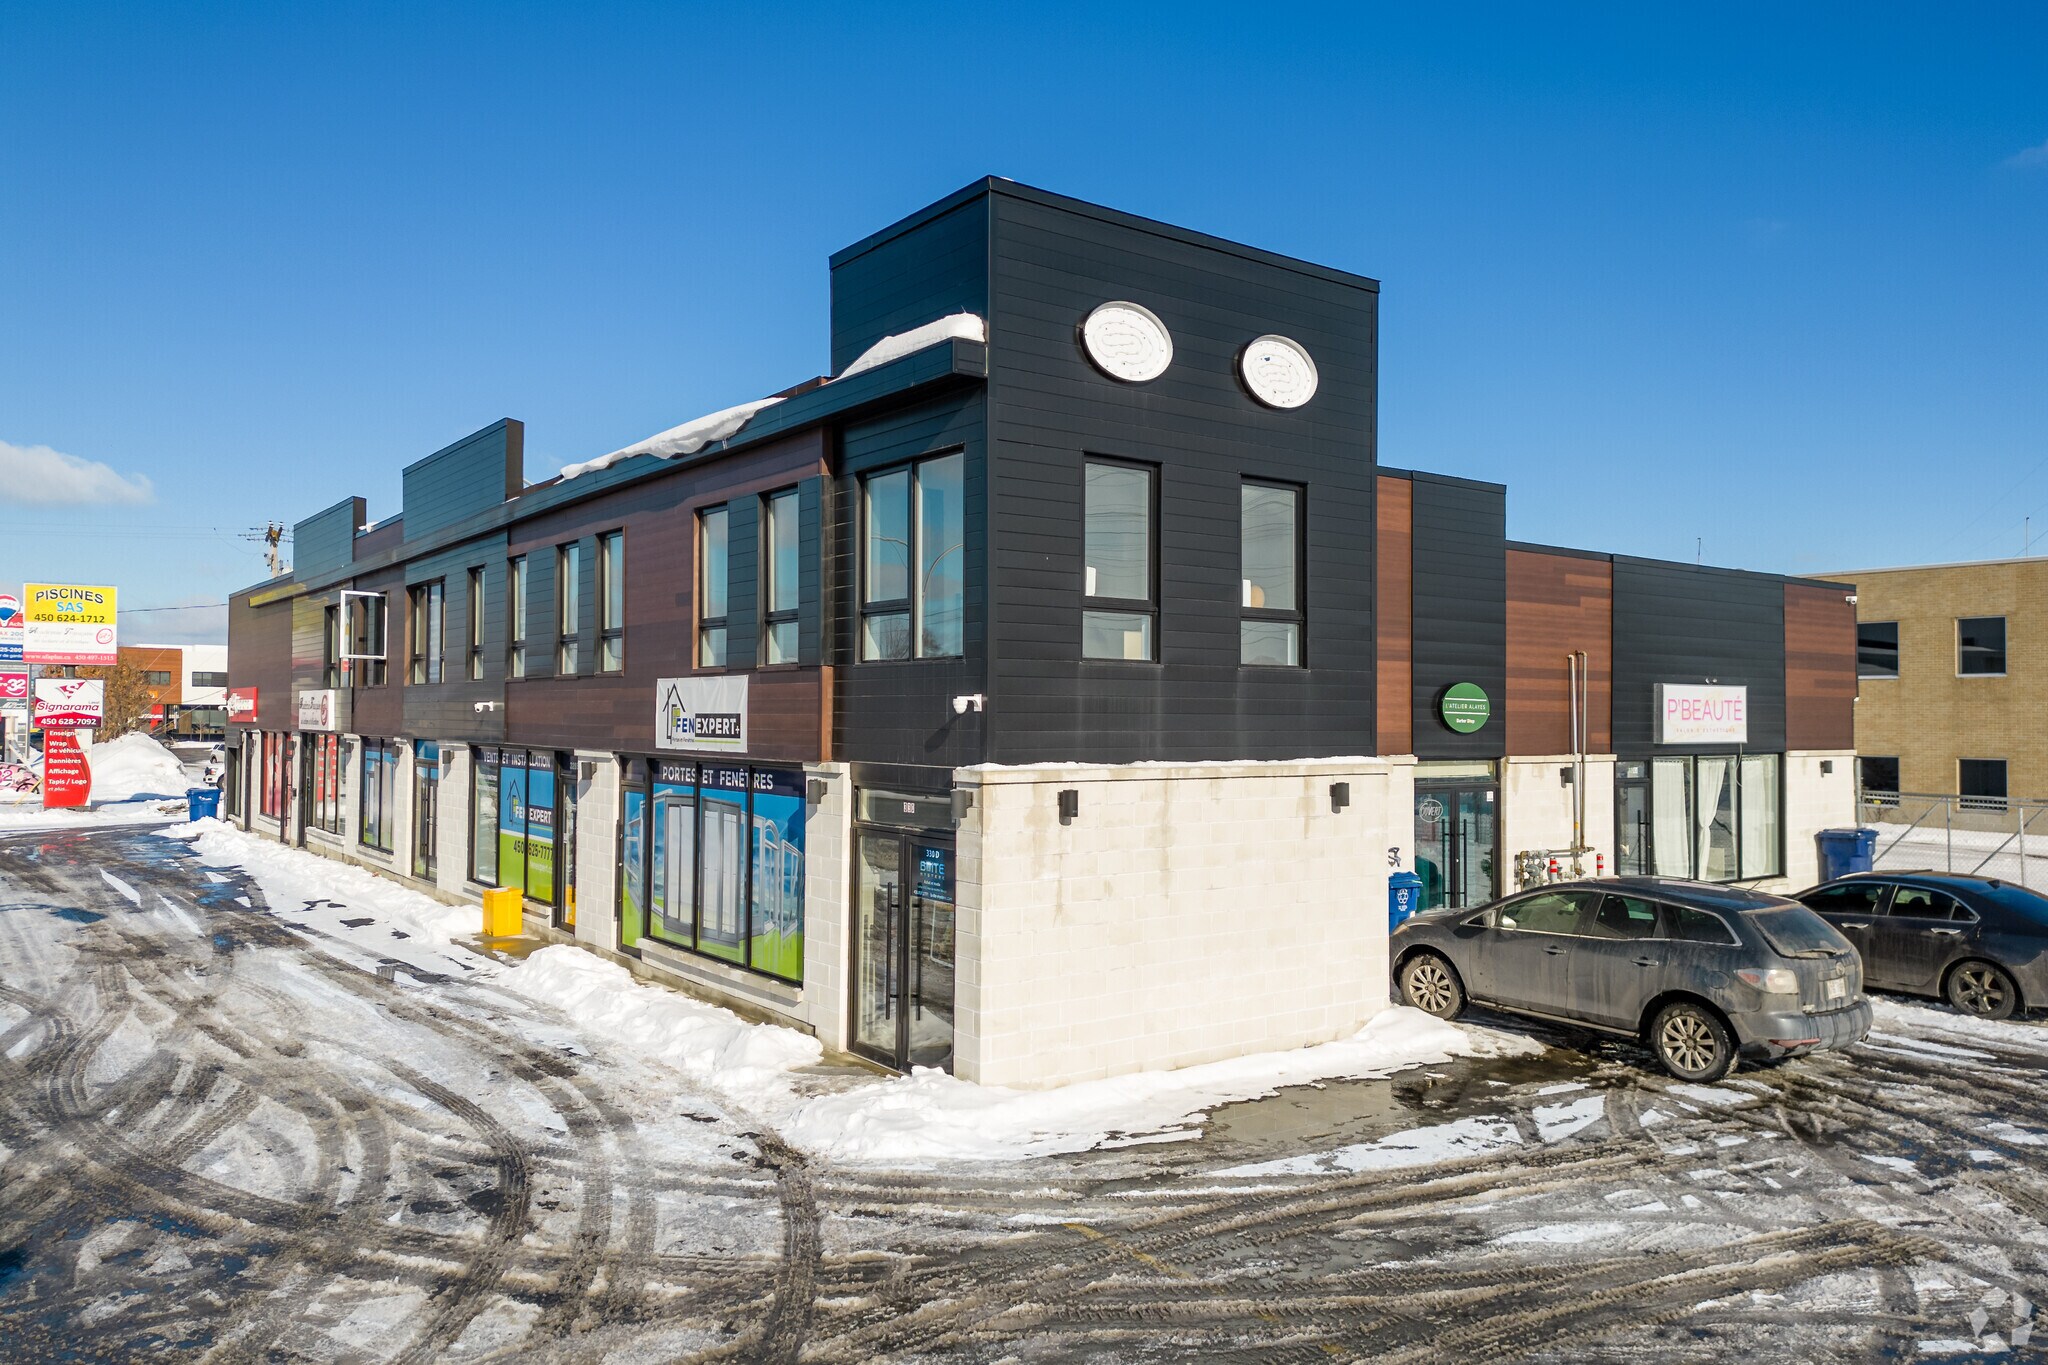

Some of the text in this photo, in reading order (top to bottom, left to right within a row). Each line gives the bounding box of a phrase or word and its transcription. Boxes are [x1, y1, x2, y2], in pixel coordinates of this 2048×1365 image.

[36, 588, 104, 604] PISCINES
[56, 601, 84, 613] SAS
[34, 613, 105, 623] 450 624-1712
[7, 678, 26, 691] 32
[37, 701, 99, 712] Signarama
[1667, 695, 1743, 720] P'BEAUTÉ
[483, 751, 498, 764] VENTE
[502, 754, 509, 765] ET
[662, 766, 774, 789] PORTES ET FENÊTRES
[514, 840, 524, 854] 450
